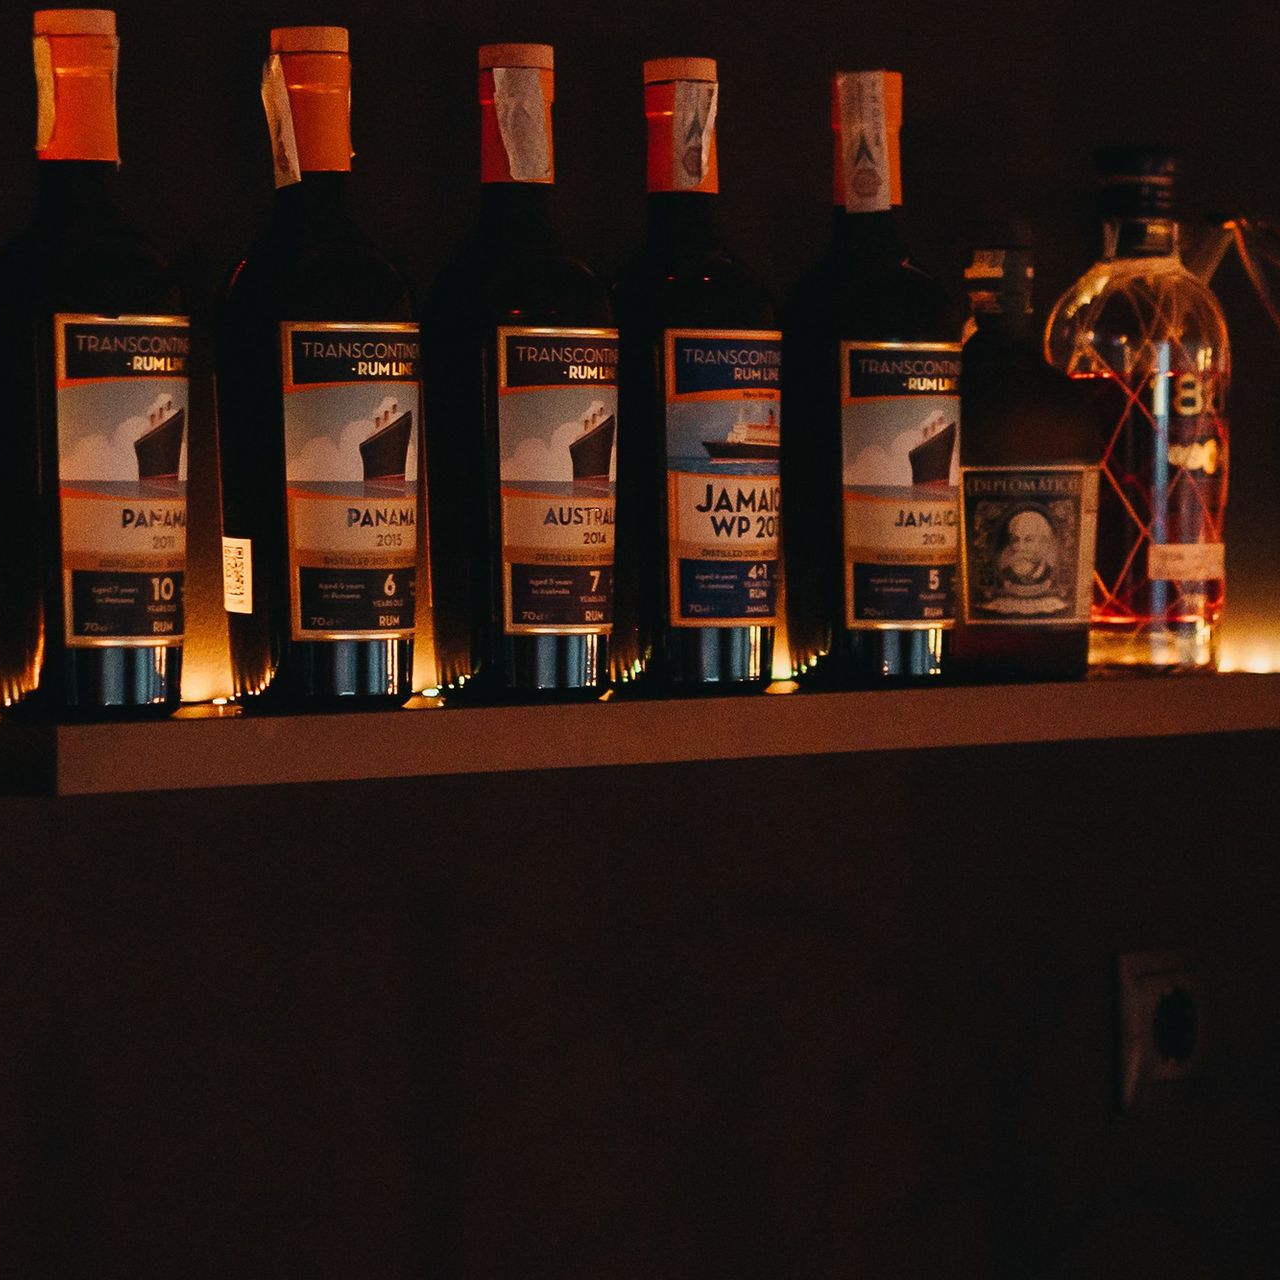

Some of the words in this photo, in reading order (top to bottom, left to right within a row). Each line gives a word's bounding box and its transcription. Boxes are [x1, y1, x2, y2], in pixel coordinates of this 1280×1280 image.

[583, 532, 607, 544] 2014
[711, 516, 750, 538] WP
[151, 577, 174, 600] 10
[383, 573, 396, 596] 6
[589, 570, 601, 592] 7
[928, 569, 940, 591] 5
[379, 616, 400, 627] RUM
